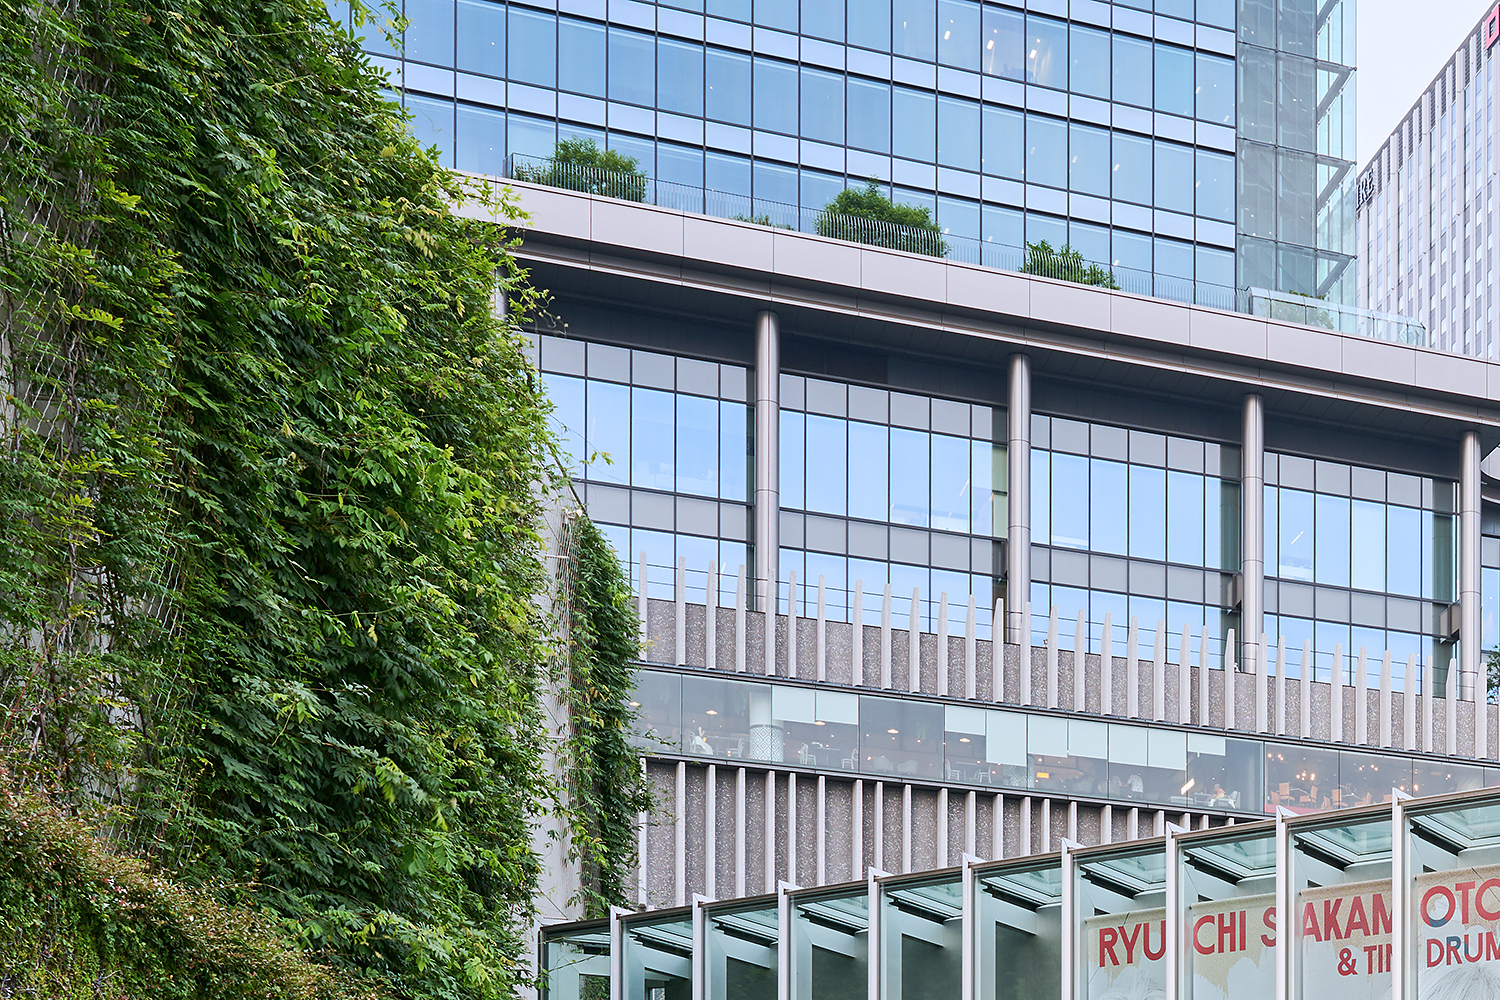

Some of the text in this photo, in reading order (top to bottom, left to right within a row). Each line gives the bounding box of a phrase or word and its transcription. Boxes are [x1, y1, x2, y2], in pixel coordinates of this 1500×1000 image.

[1099, 910, 1247, 968] RYUCHI
[1337, 947, 1358, 977] &
[1363, 942, 1393, 975] TI
